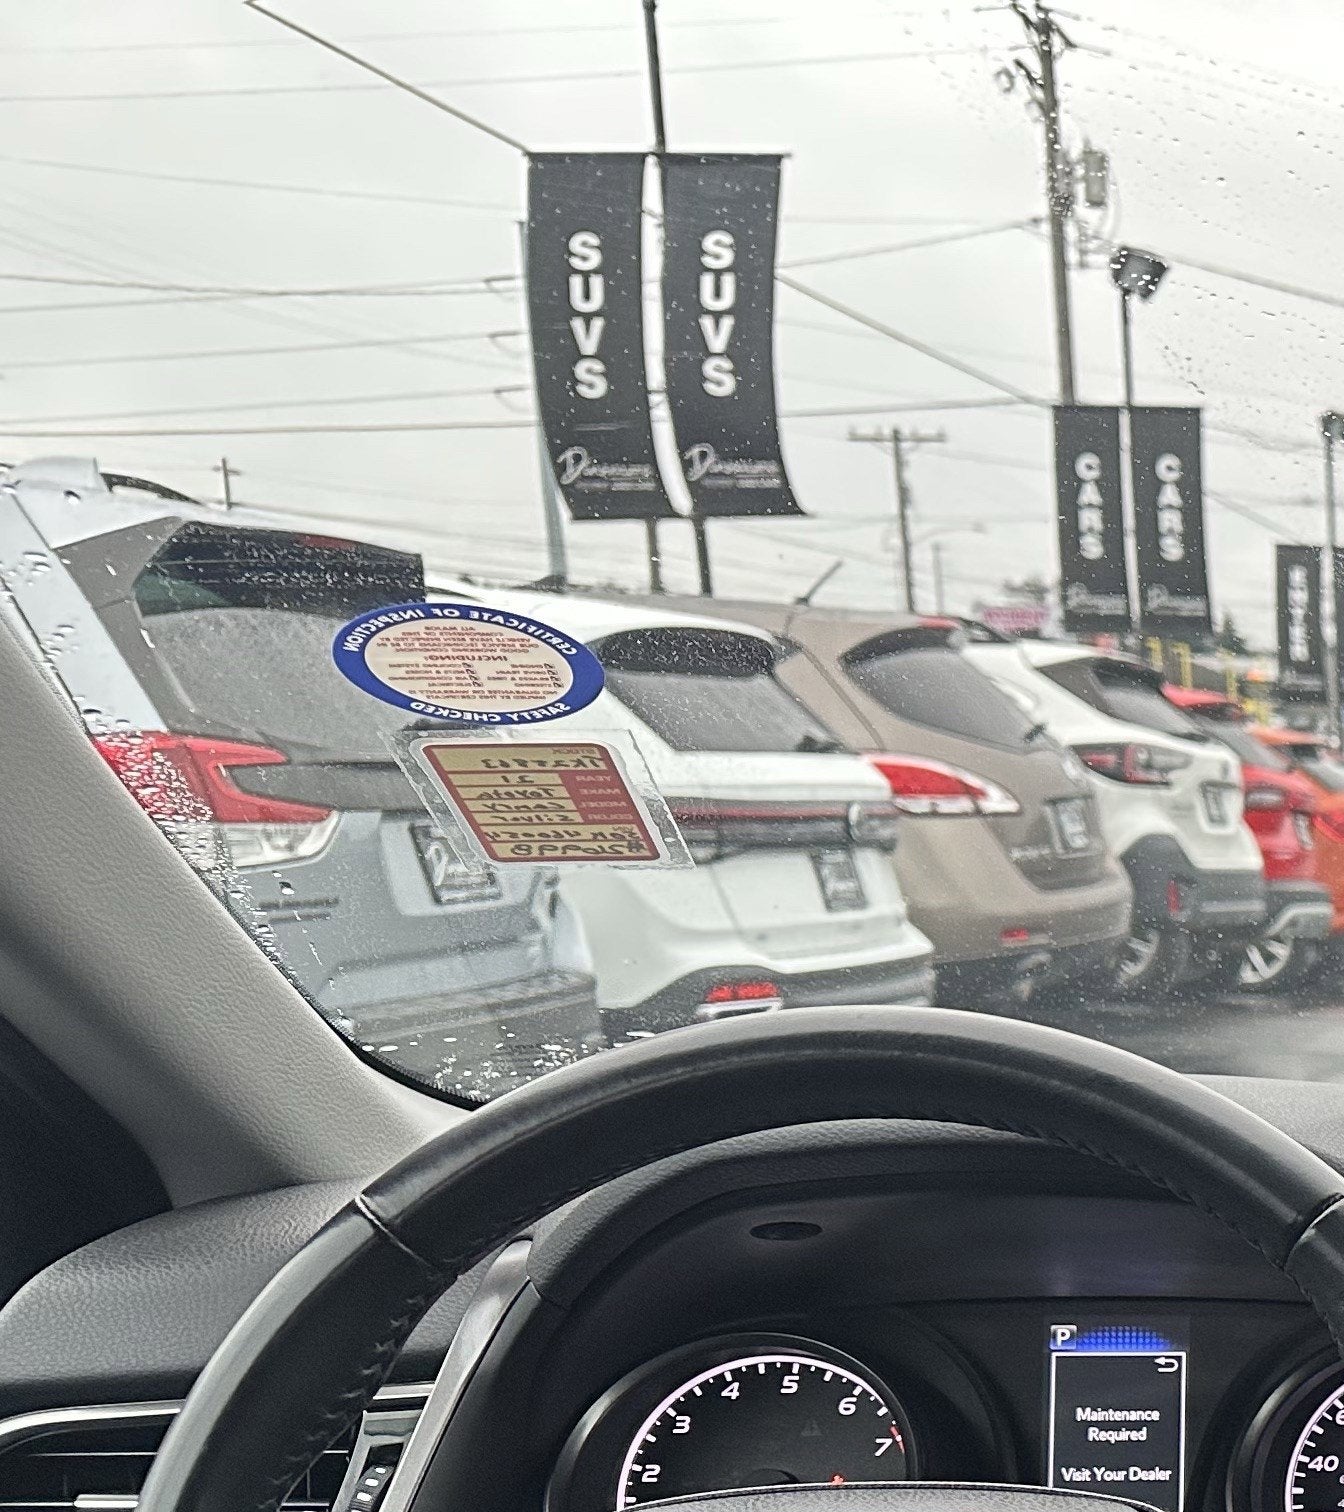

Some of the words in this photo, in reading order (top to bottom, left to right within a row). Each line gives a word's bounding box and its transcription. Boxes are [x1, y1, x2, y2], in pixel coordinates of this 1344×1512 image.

[567, 230, 608, 399] SUVS
[699, 229, 736, 397] SUVS
[1074, 451, 1105, 561] CARS
[1154, 453, 1184, 563] CARS
[1056, 1329, 1071, 1347] P
[720, 1382, 741, 1401] 4
[780, 1375, 800, 1394] 5
[837, 1396, 857, 1416] 6
[1075, 1407, 1161, 1422] Maintenance
[672, 1415, 692, 1435] 3
[1087, 1427, 1148, 1444] Required
[874, 1437, 893, 1457] 7
[641, 1464, 661, 1483] 2
[1307, 1455, 1340, 1473] 40
[1060, 1467, 1091, 1481] Visit
[1092, 1466, 1128, 1482] Your
[1128, 1466, 1172, 1482] Dealer
